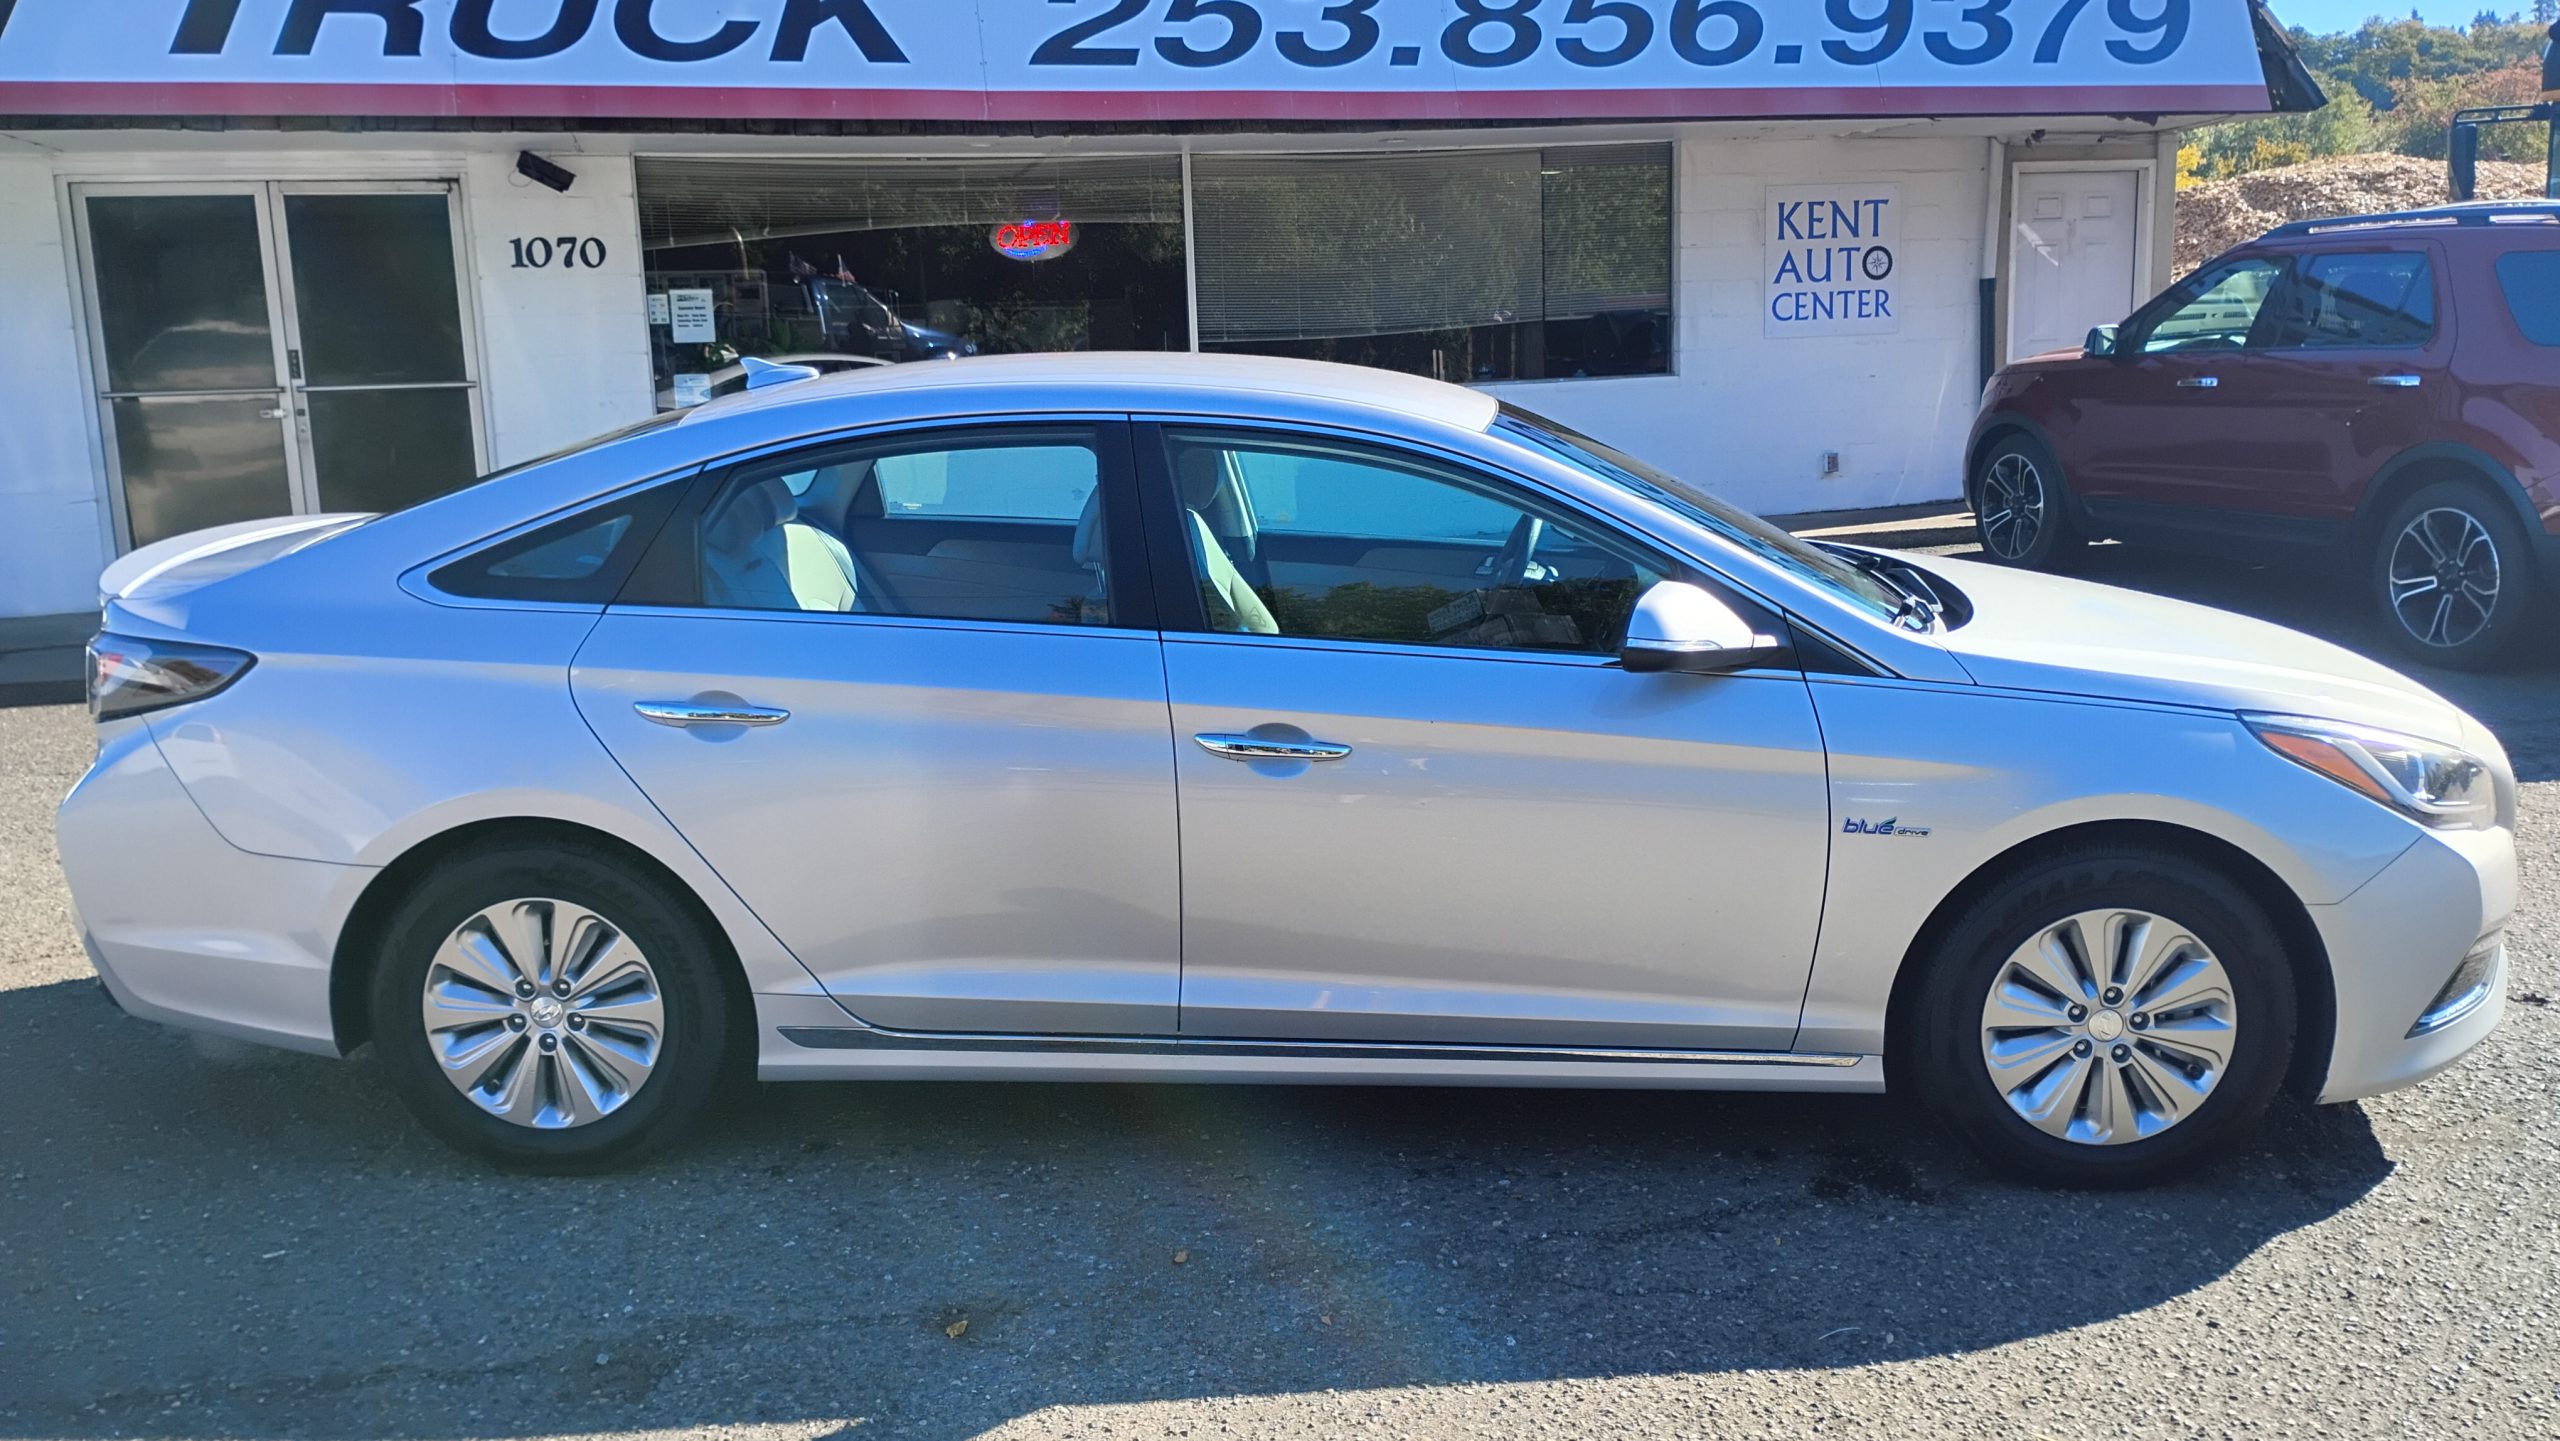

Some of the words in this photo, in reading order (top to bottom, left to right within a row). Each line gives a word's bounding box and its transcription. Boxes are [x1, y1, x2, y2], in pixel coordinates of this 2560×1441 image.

[1028, 0, 2192, 68] 253.856.9379
[996, 220, 1071, 249] OPEN
[1777, 199, 1890, 240] KENT
[508, 236, 607, 269] 1070
[1773, 245, 1893, 284] AUTO
[1771, 289, 1892, 321] CENTER
[1842, 816, 1897, 836] blue
[1897, 827, 1930, 837] drive
